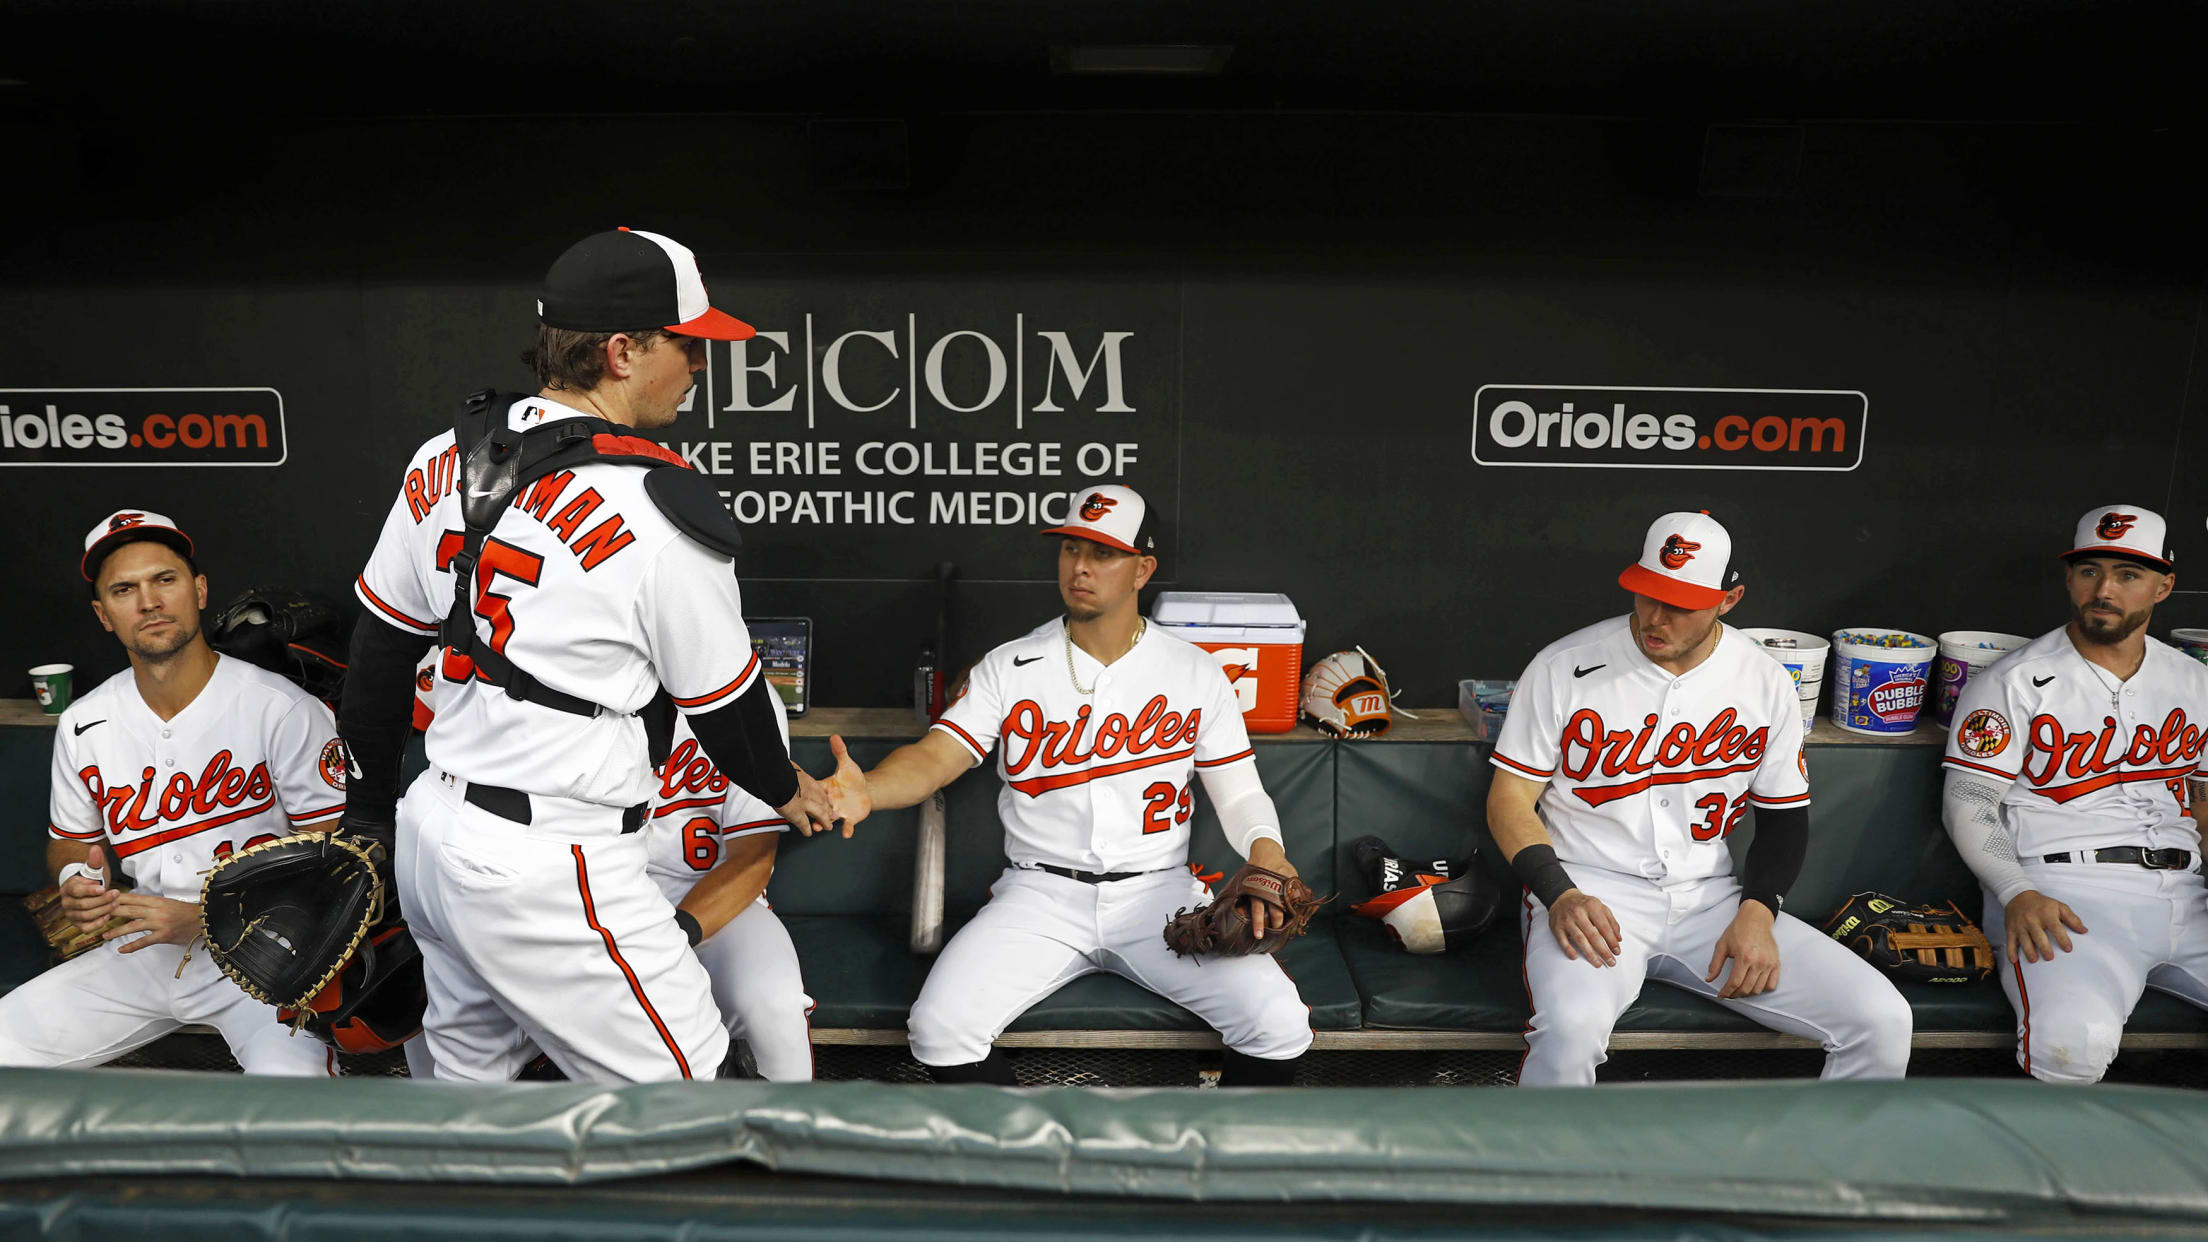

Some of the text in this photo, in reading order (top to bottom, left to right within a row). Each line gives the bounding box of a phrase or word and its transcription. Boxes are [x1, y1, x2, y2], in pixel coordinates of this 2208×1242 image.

[677, 331, 1136, 412] ECOM
[0, 405, 268, 449] ioles.com
[1489, 400, 1846, 452] Orioles.com
[658, 442, 1139, 476] KE ERIE COLLEGE OF
[404, 444, 636, 573] RUTMAN
[719, 491, 1079, 524] OPATHIC MEDIC
[1874, 684, 1925, 702] DUBBLE
[1876, 695, 1924, 713] BUBBLE
[1001, 694, 1202, 776] Orioles
[1560, 707, 1771, 782] Orioles
[2021, 708, 2208, 786] Oriole
[682, 816, 720, 871] 6
[1832, 915, 1861, 940] Wilso
